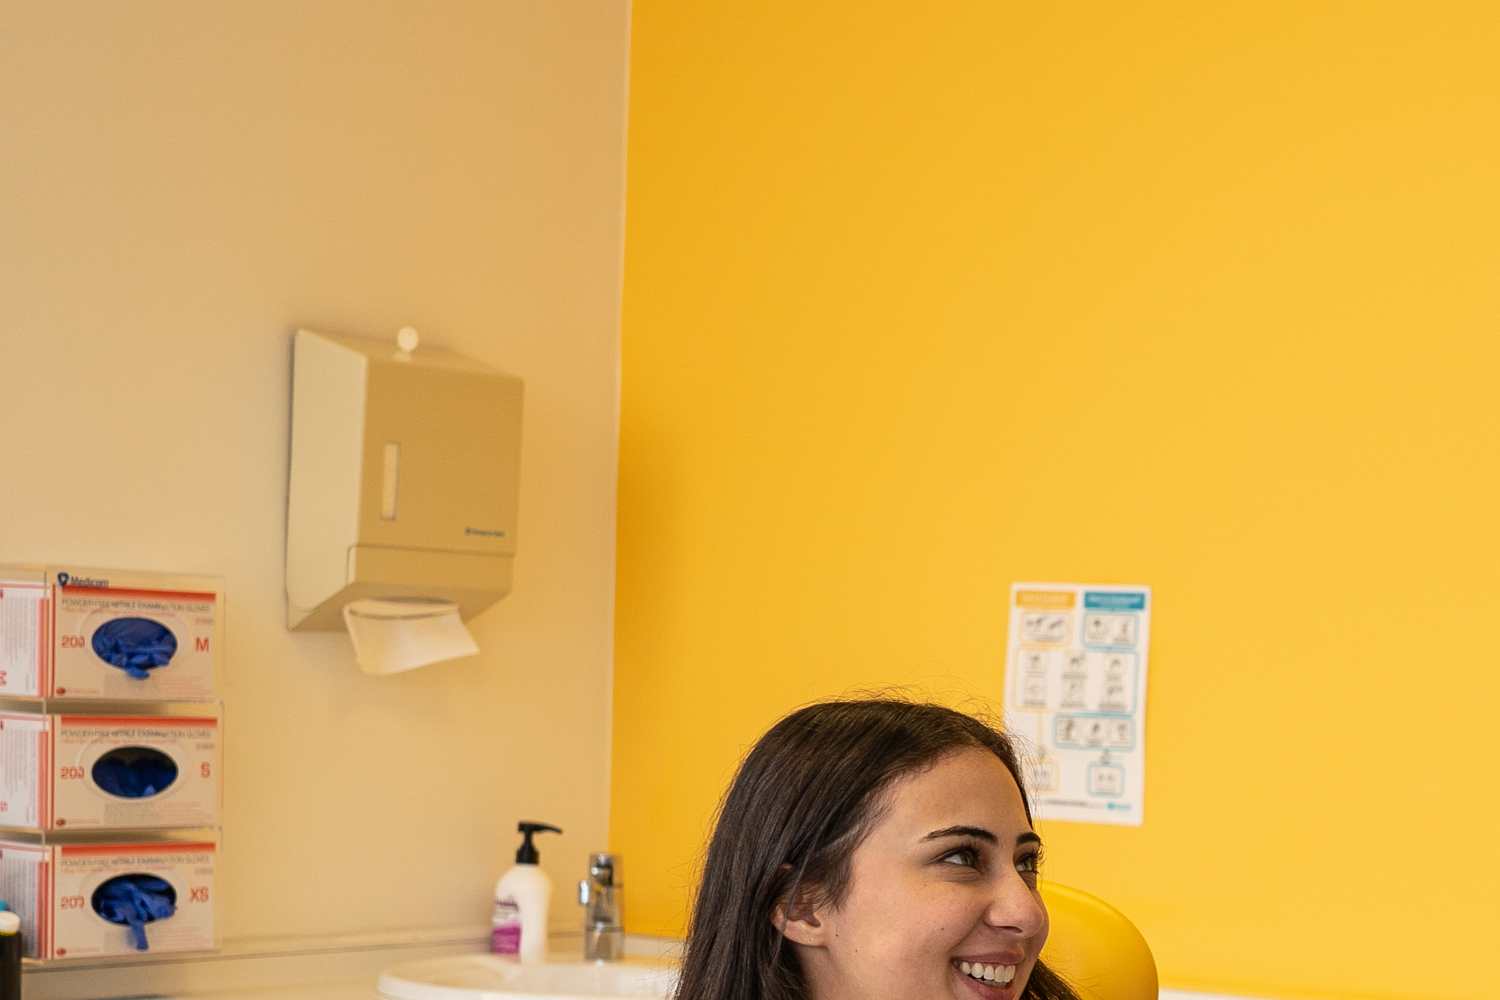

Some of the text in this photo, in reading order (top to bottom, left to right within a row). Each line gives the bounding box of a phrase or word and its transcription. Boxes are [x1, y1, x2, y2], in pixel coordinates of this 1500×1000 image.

[71, 576, 109, 587] Medicom
[195, 636, 210, 652] M
[201, 761, 211, 779] S
[189, 886, 210, 903] XS
